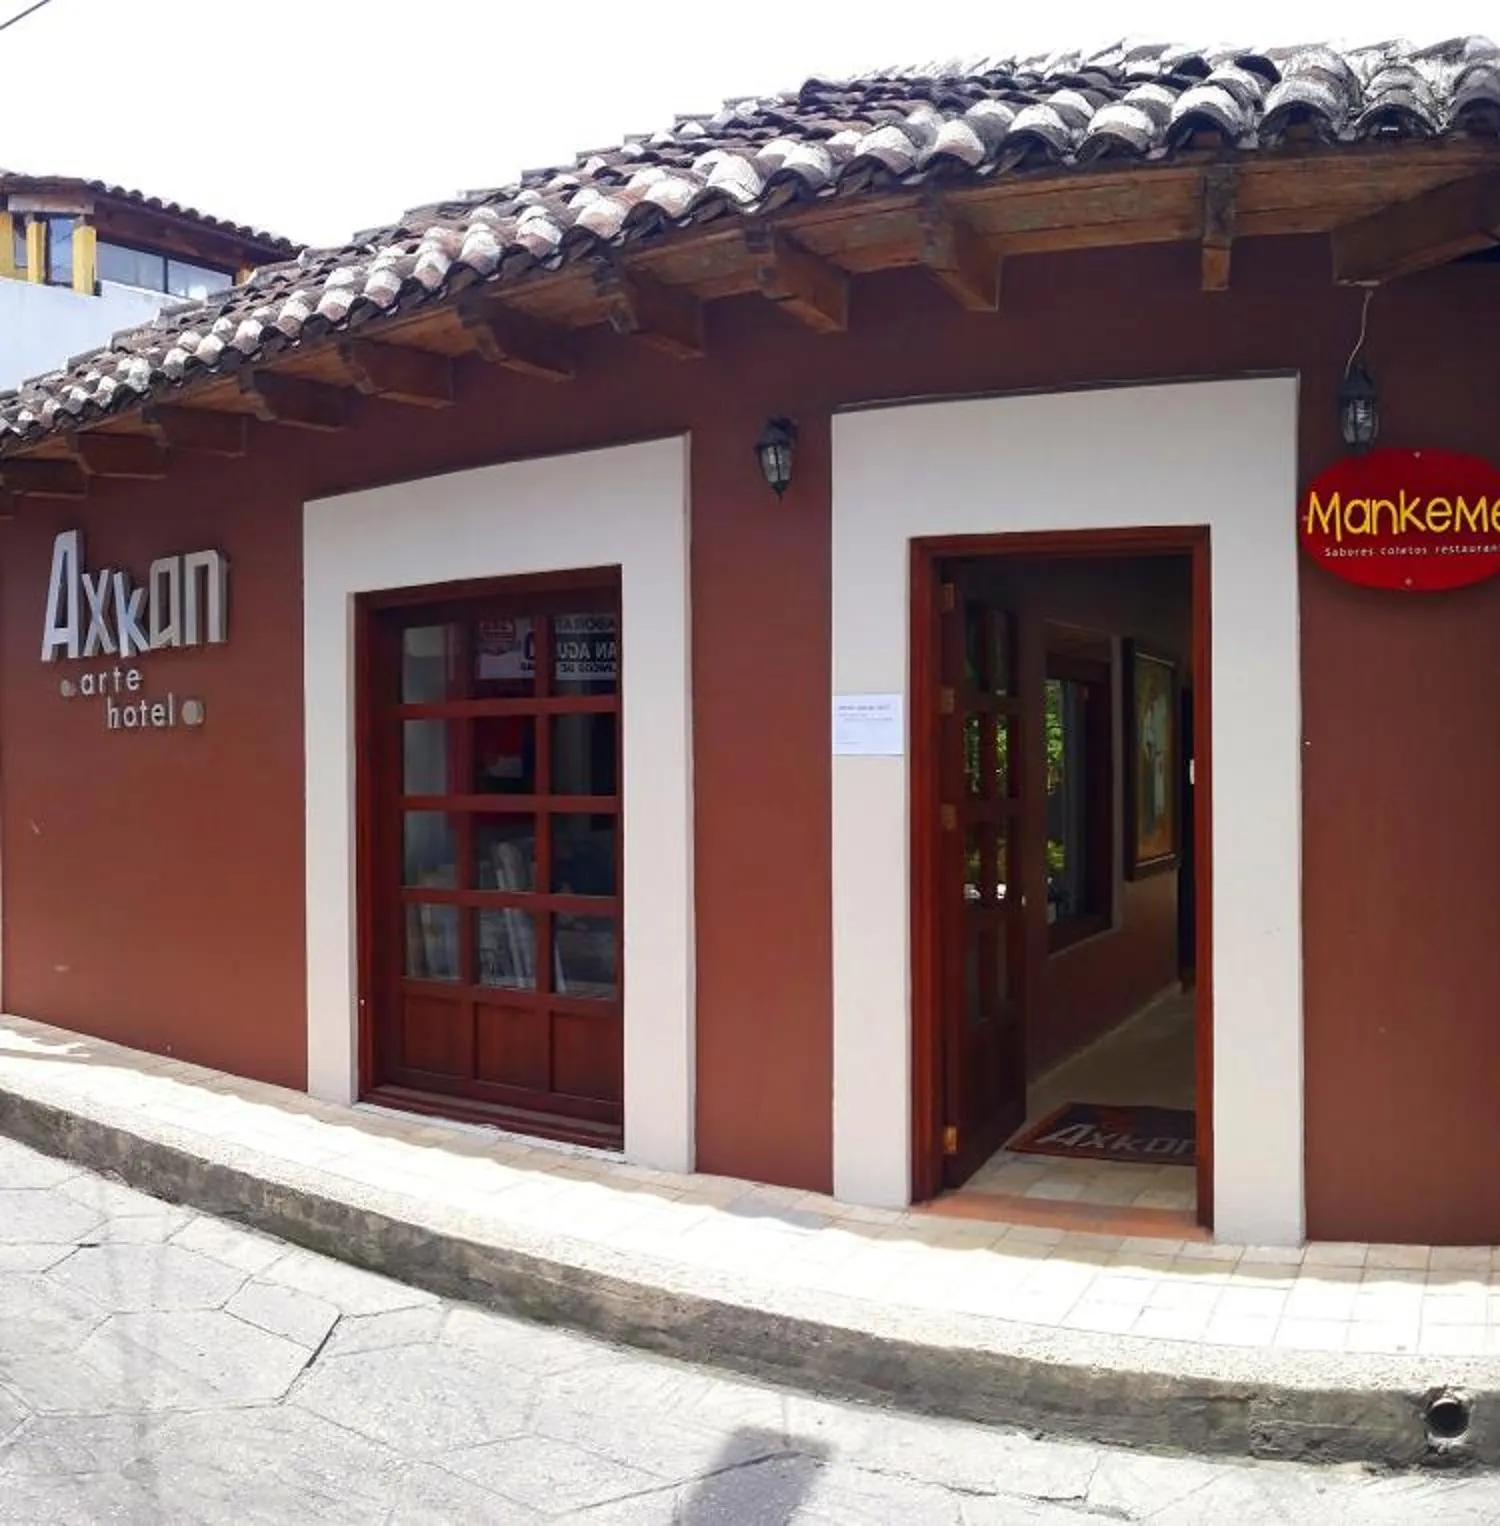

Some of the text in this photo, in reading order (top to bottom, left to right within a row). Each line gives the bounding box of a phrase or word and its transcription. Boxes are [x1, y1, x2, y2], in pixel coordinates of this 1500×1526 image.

[1324, 546, 1374, 557] Sabores
[1380, 544, 1427, 555] coletos
[41, 529, 227, 661] Axkan
[80, 667, 141, 695] arte
[107, 692, 173, 729] hotel
